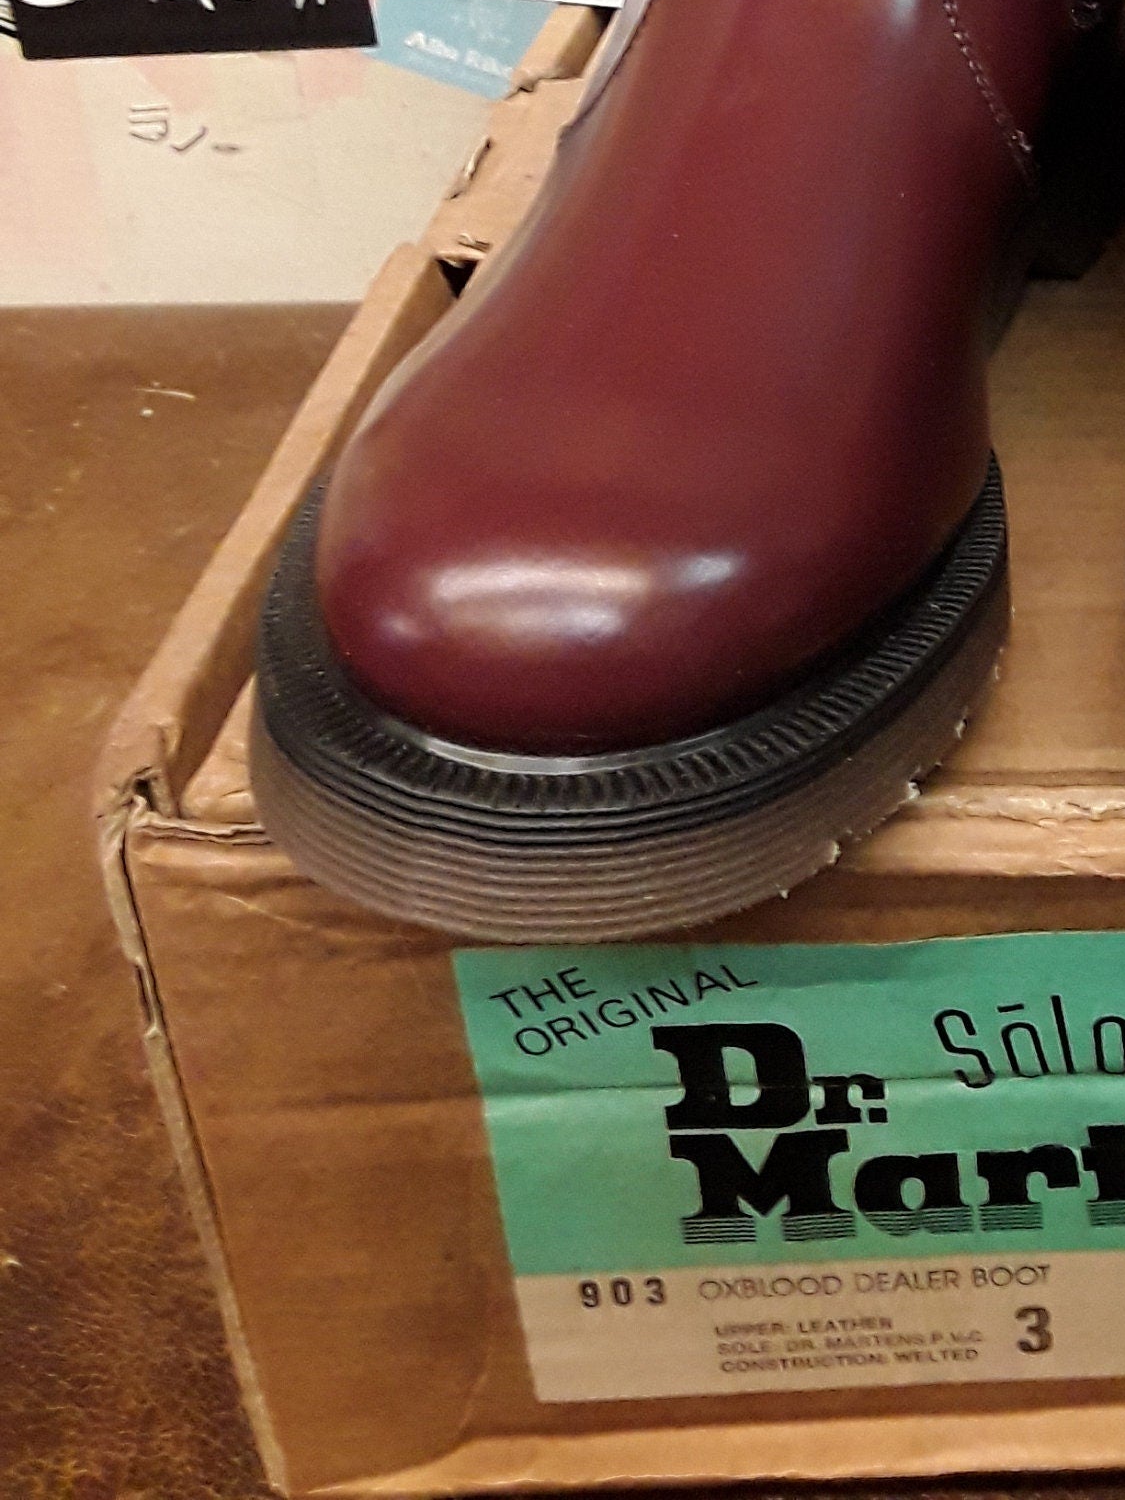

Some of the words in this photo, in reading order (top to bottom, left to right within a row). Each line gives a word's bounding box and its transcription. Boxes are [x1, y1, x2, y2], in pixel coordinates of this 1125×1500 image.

[488, 966, 598, 1019] THE
[515, 964, 760, 1058] ORIGINAL
[650, 1022, 888, 1131] Dr.
[699, 1275, 843, 1301] OXBLOOD
[854, 1269, 960, 1294] DEALER
[971, 1264, 1051, 1288] BOOT
[797, 1316, 893, 1334] LEATHER
[1015, 1305, 1054, 1355] 3
